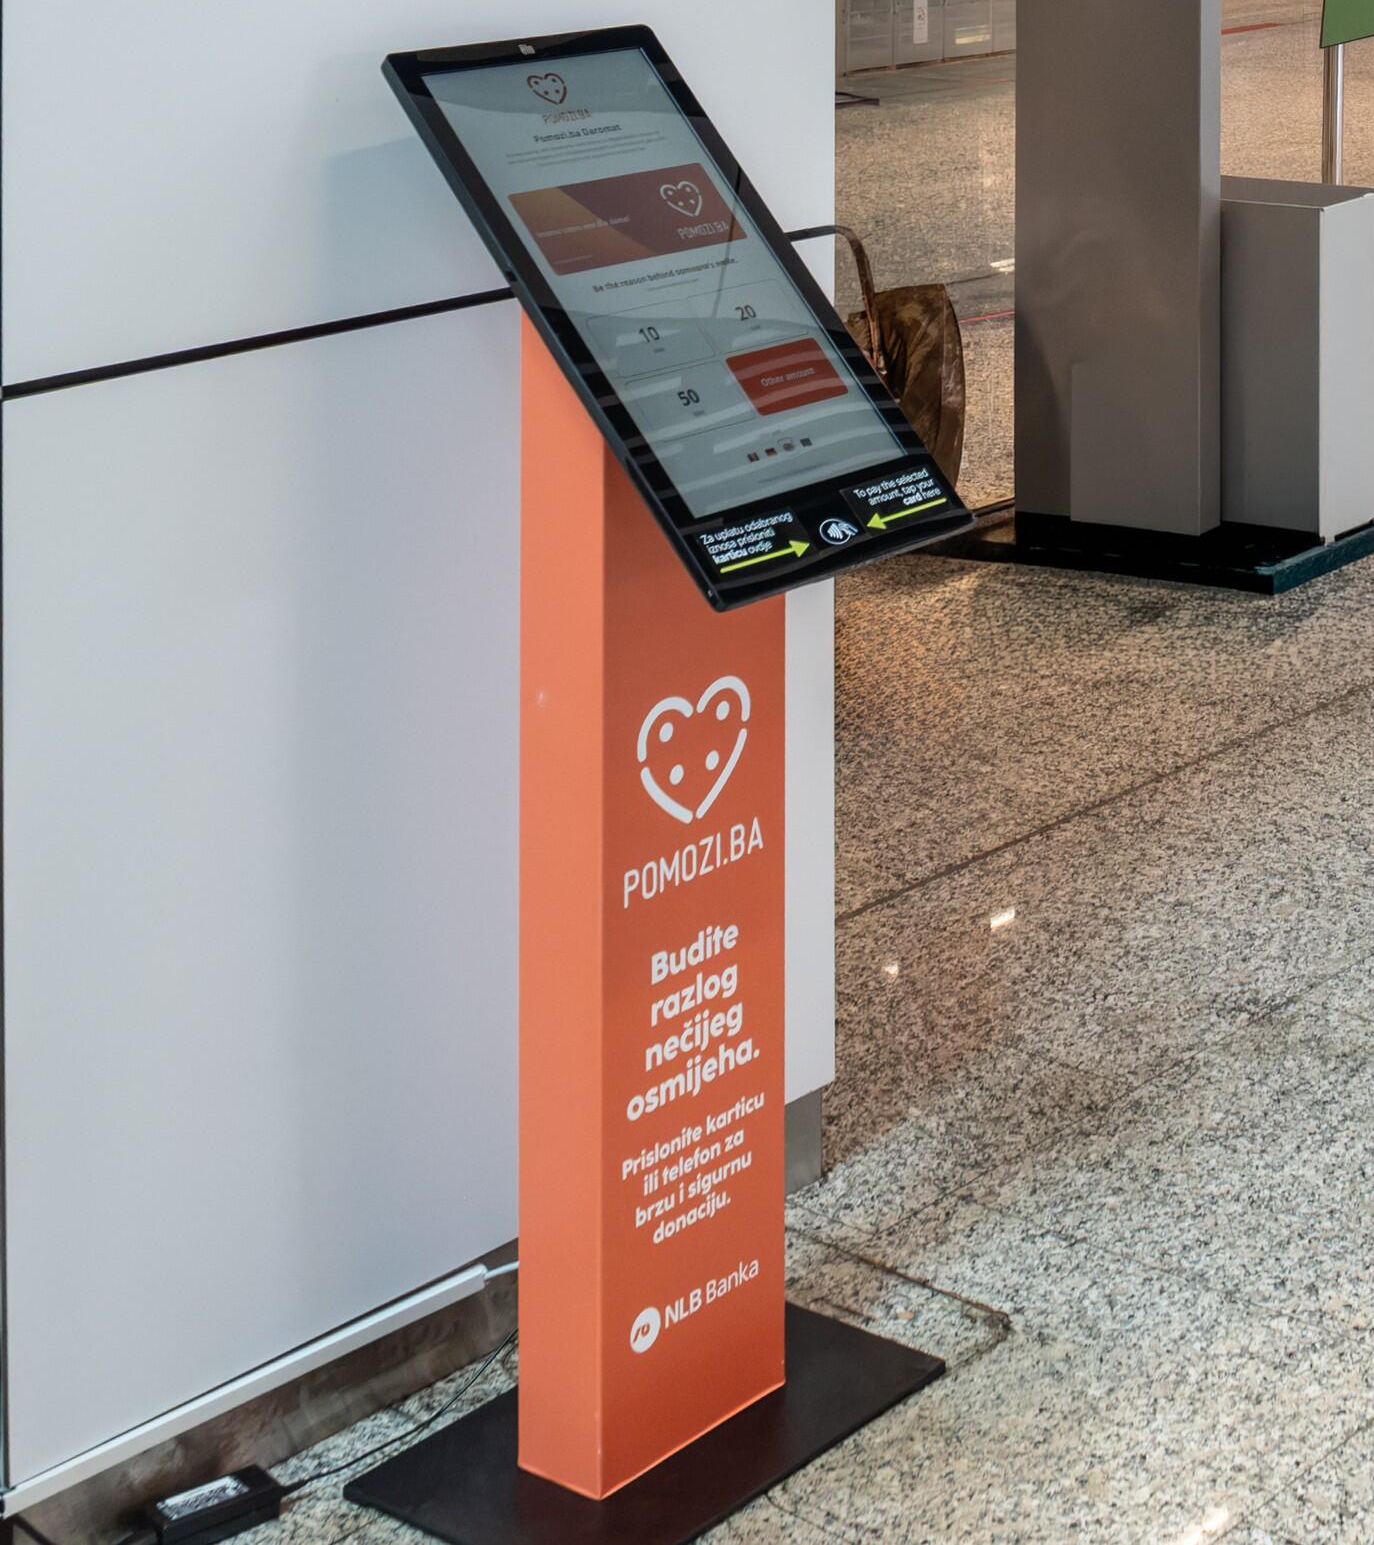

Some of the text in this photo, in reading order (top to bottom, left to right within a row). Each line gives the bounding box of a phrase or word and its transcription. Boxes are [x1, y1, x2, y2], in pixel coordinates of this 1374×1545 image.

[619, 276, 645, 288] reason
[647, 269, 675, 282] behind
[735, 305, 757, 321] 20
[638, 326, 660, 343] 10
[677, 389, 700, 407] 50
[760, 375, 784, 387] Other
[853, 467, 929, 498] To pay the selected
[868, 478, 934, 506] amount, tap your
[902, 487, 941, 505] card here
[700, 511, 793, 545] Za uplatu odabranog
[706, 526, 776, 554] iznosa prisloniti
[712, 540, 773, 565] karticu ovdje
[623, 816, 763, 910] POMOZI.BA
[651, 924, 739, 985] Budite
[651, 963, 738, 1028] razlog
[645, 1001, 743, 1072] nečijeg
[626, 1038, 760, 1121] osmijeha.
[622, 1091, 765, 1181] Prislonite karticu
[643, 1129, 744, 1196] ili telefon za
[635, 1151, 752, 1228] brzu i sigurnu
[653, 1191, 731, 1244] donaciju.
[664, 1257, 760, 1329] NLB Banka
